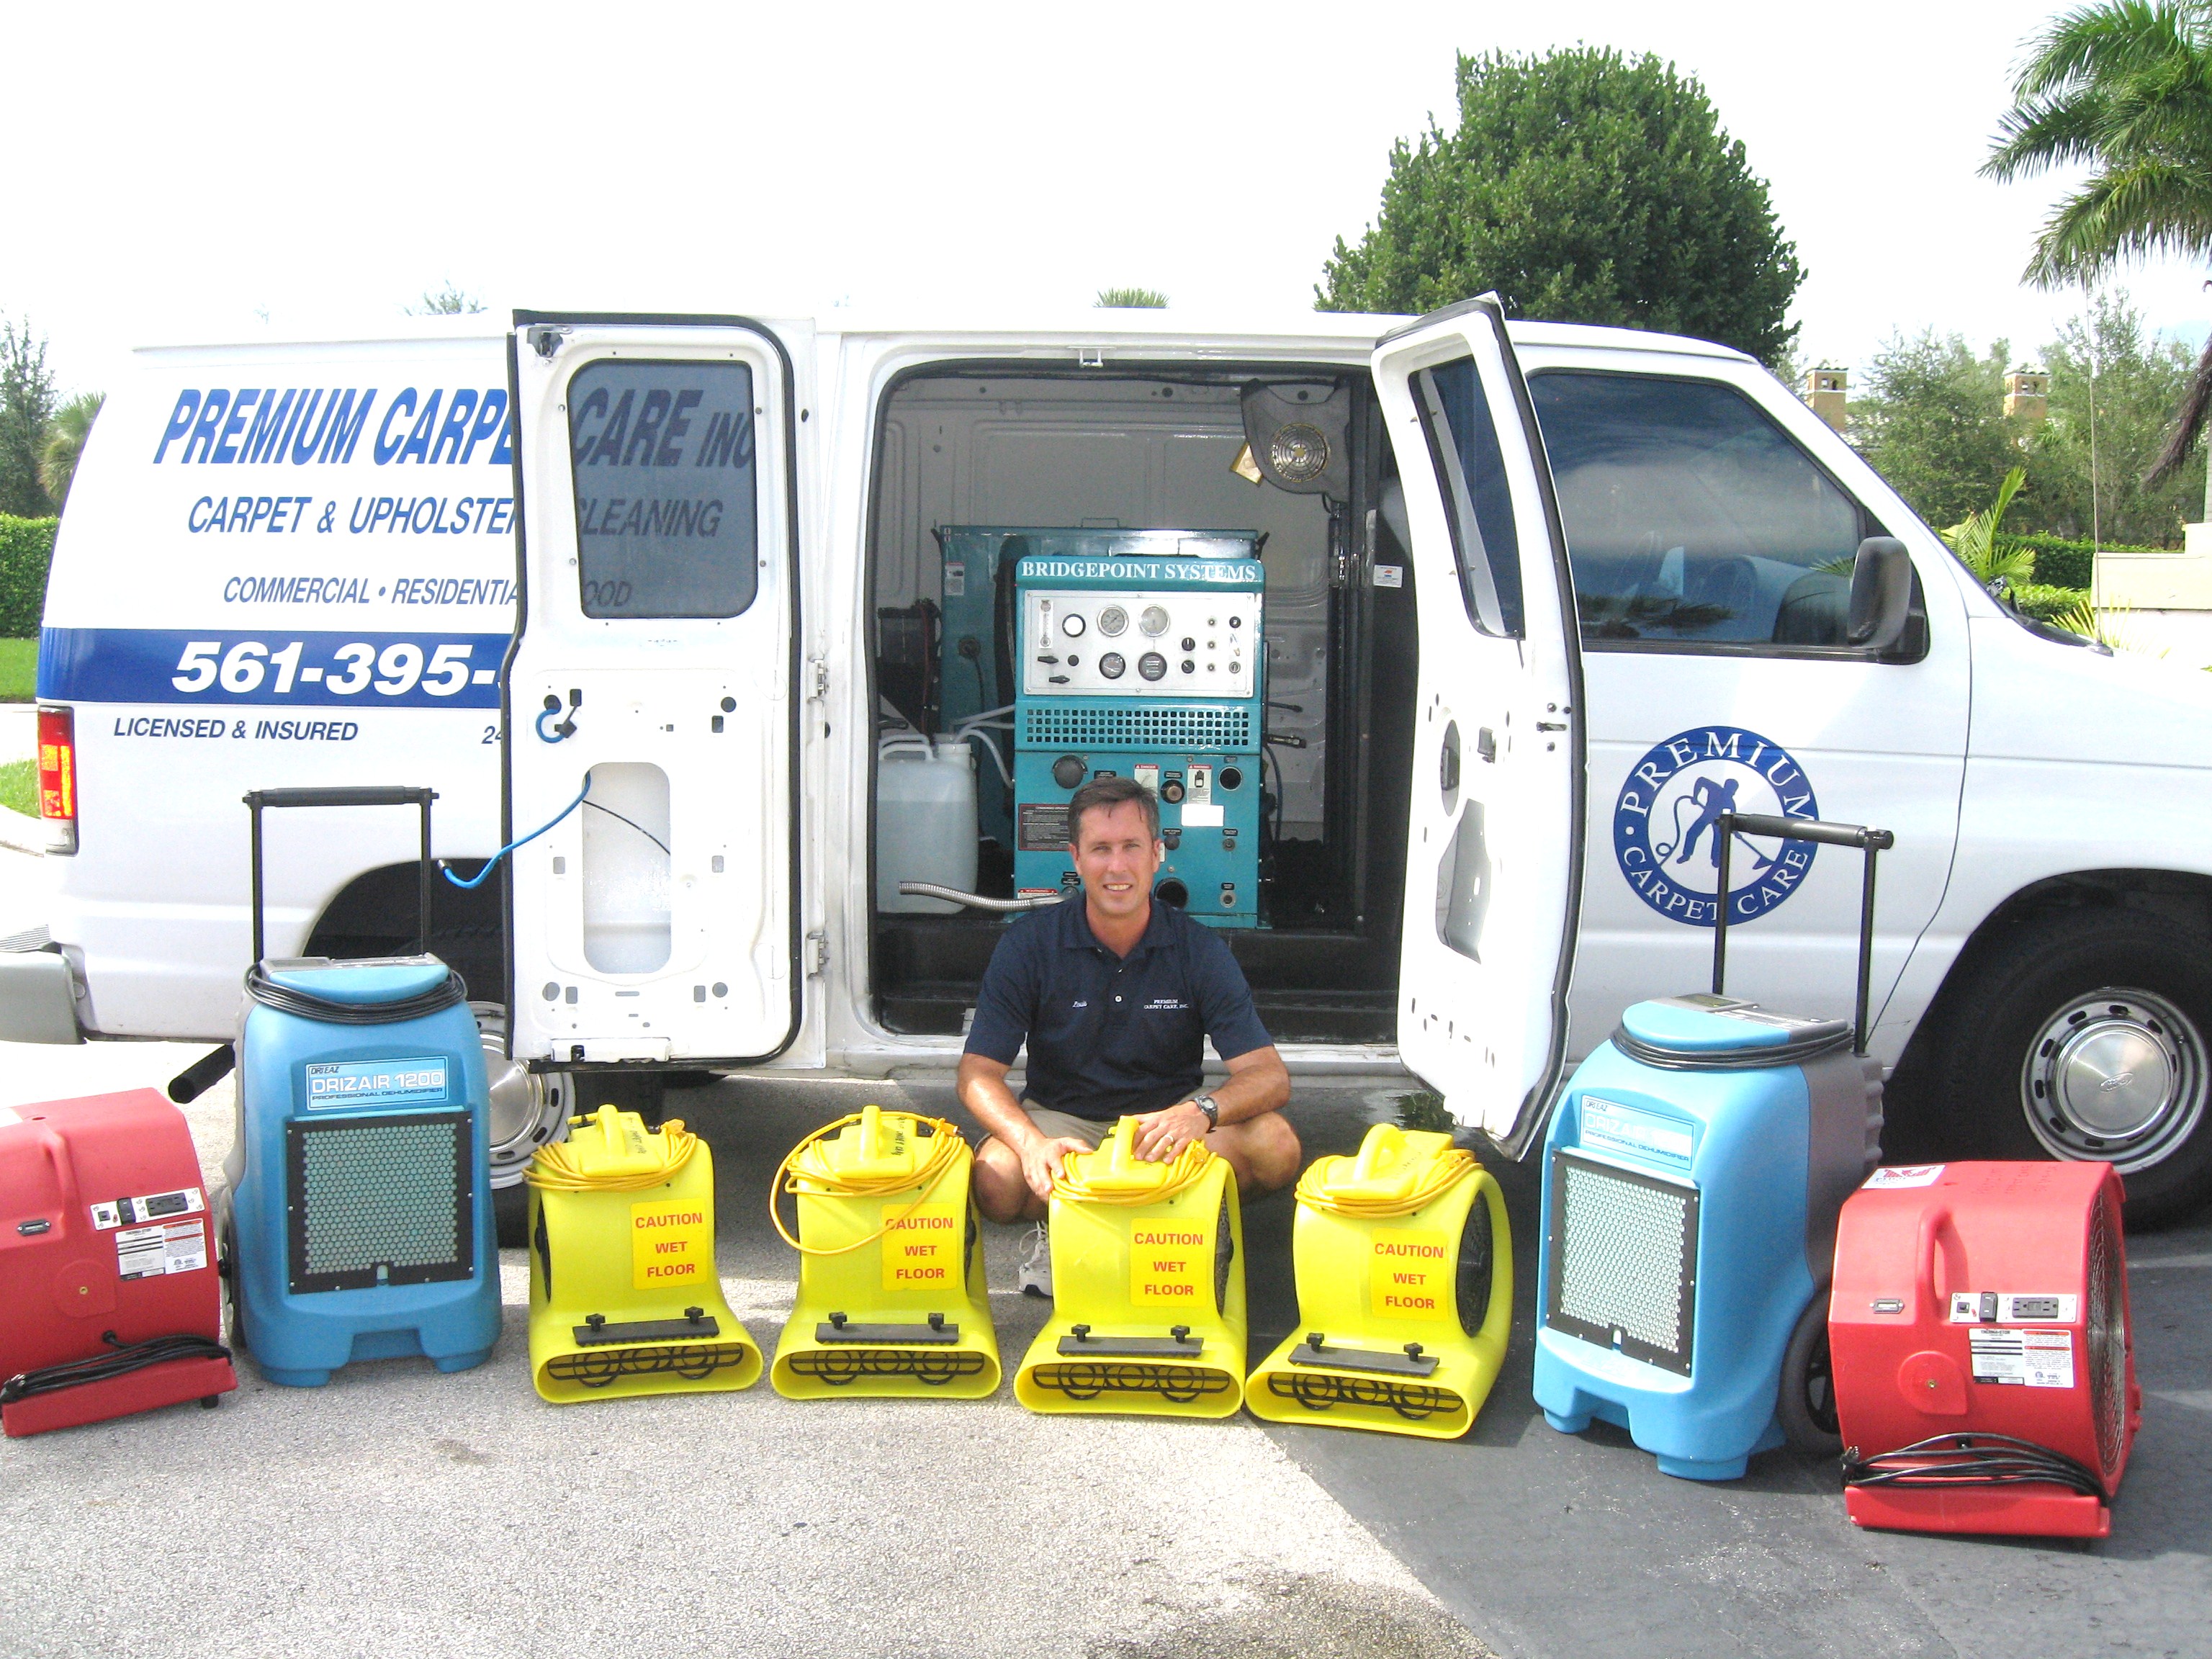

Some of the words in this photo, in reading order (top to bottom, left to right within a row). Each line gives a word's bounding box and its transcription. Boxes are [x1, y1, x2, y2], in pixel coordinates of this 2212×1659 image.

[153, 388, 377, 464] PREMIUM
[373, 387, 512, 466] CARPE
[571, 387, 703, 467] CARE
[188, 495, 312, 534] CARPET
[316, 500, 336, 534] &
[349, 495, 516, 534] UPHOLSTE
[1022, 562, 1160, 579] BRIDGEPOINT
[1164, 564, 1256, 580] SYSTEMS
[223, 576, 369, 603] COMMERCIAL
[391, 578, 518, 606] RESIDENTIA
[583, 580, 633, 608] OOD
[171, 640, 501, 697] 561-395-
[114, 717, 225, 739] LICENSED
[232, 720, 247, 739] &
[254, 719, 359, 741] INSURED
[1620, 731, 1816, 822] PREMIUM
[1624, 847, 1719, 920] CARPET
[1737, 851, 1809, 914] CARE
[312, 1074, 390, 1093] DRIZAIR
[394, 1071, 443, 1087] 1200
[312, 1092, 379, 1100] PROFESSIONAL
[1585, 1112, 1647, 1143] DRIZAIR
[1585, 1129, 1637, 1148] PROFESSIONAL
[635, 1212, 703, 1228] CAUTION
[884, 1217, 953, 1231] CAUTION
[1133, 1232, 1204, 1245] CAUTION
[655, 1241, 688, 1254] WET
[904, 1244, 937, 1257] WET
[1374, 1243, 1444, 1259] CAUTION
[647, 1263, 696, 1277] FLOOR
[895, 1267, 945, 1280] FLOOR
[1153, 1260, 1187, 1272] WET
[1393, 1272, 1426, 1285] WET
[1143, 1284, 1194, 1296] FLOOR
[1385, 1295, 1435, 1310] FLOOR
